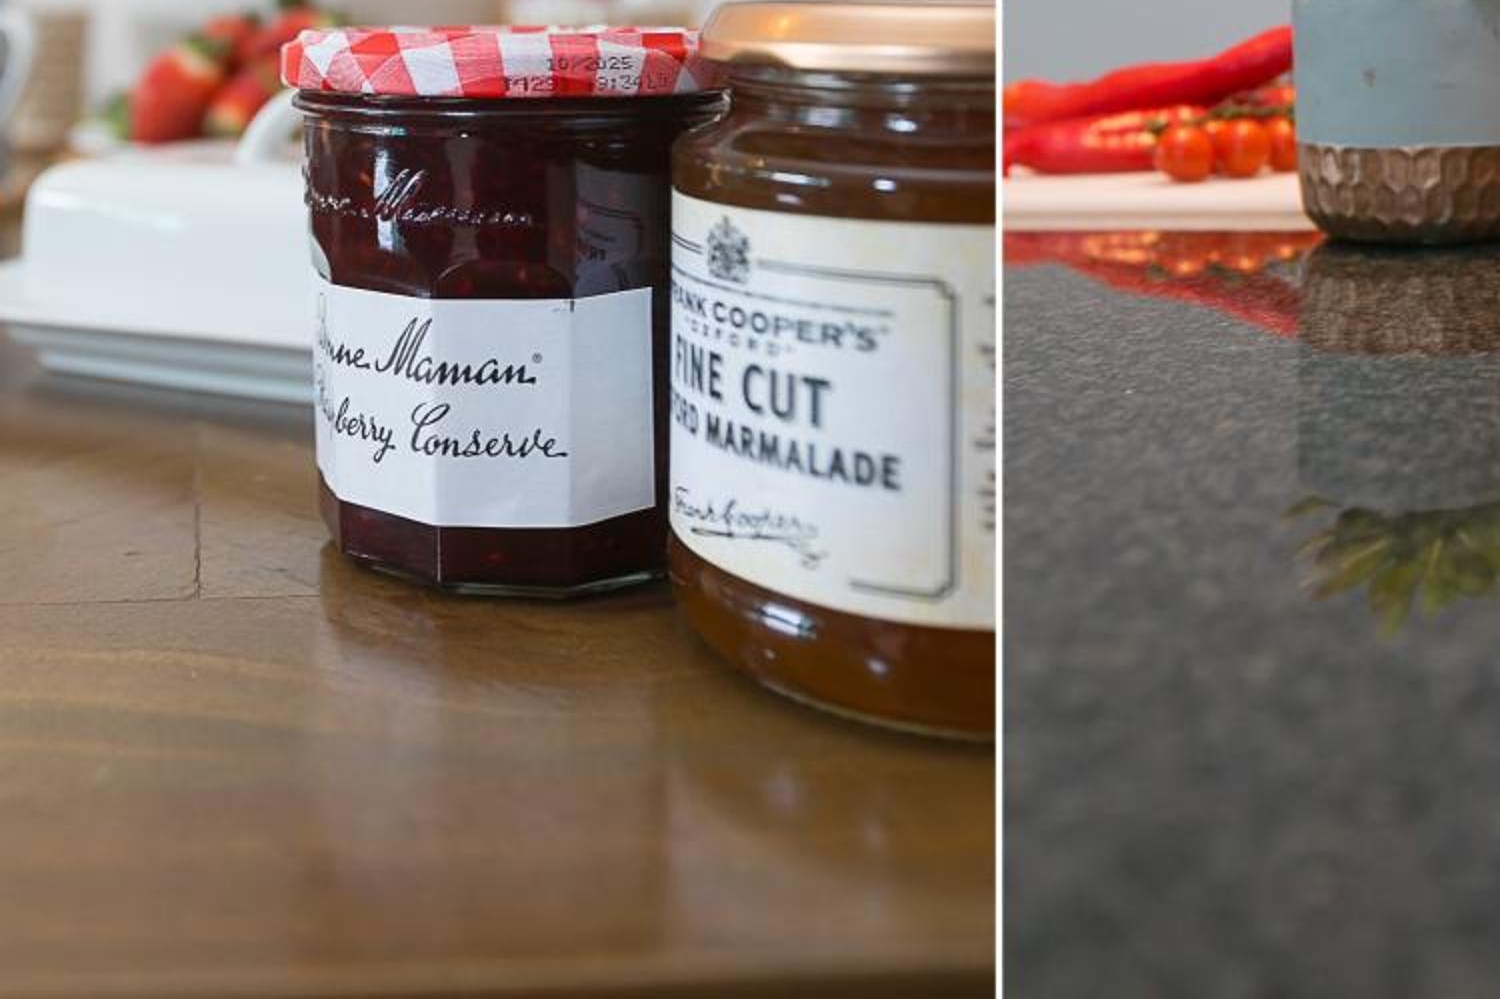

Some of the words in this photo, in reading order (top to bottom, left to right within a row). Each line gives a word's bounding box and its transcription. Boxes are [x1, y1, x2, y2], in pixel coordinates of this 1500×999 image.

[545, 56, 634, 71] 10/2025
[375, 316, 537, 385] Maman
[712, 301, 880, 353] COOPER'S
[676, 333, 723, 402] FINE
[742, 363, 832, 429] CUT
[410, 402, 568, 459] Conserve
[706, 412, 903, 491] MARMALADE
